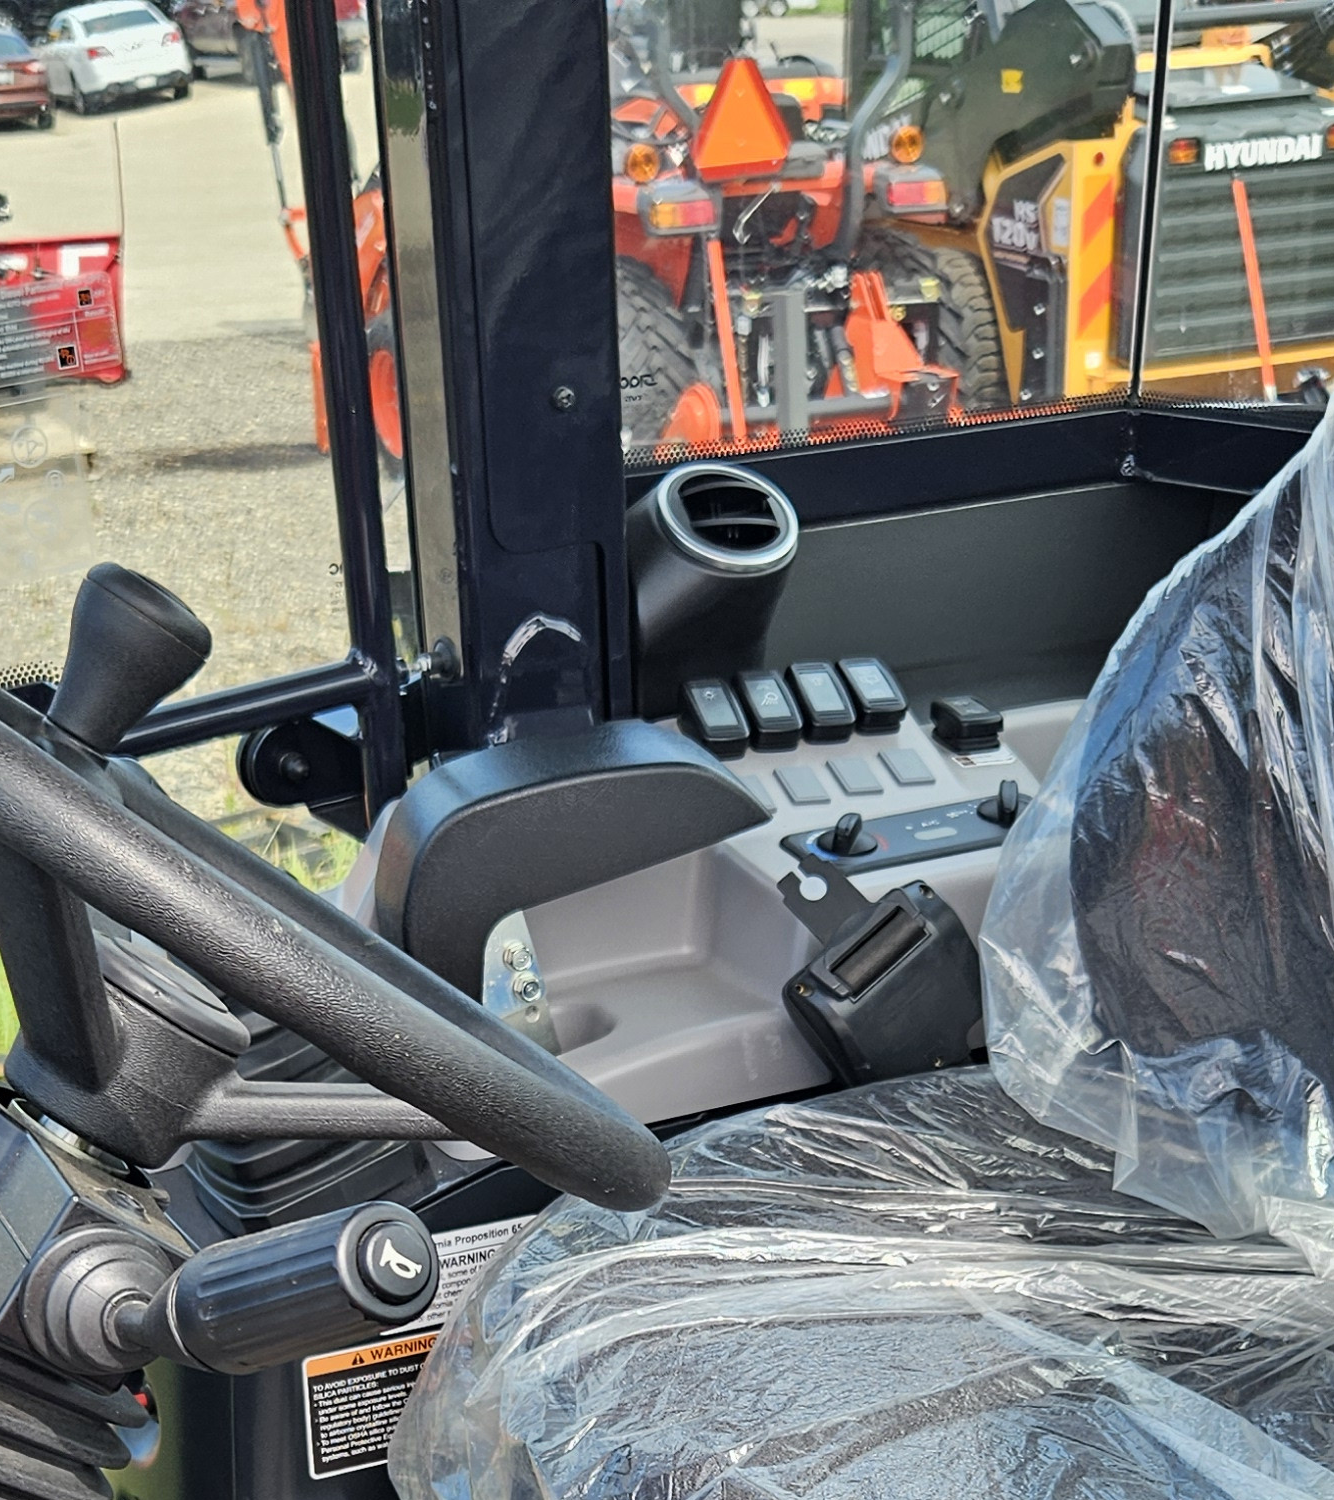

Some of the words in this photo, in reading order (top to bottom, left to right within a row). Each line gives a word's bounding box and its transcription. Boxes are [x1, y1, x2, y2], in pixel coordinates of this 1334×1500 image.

[1204, 133, 1324, 172] HYUNDAI
[455, 1226, 509, 1246] Proposition
[313, 1384, 324, 1393] TO
[324, 1380, 346, 1390] AVOID
[347, 1371, 387, 1385] EXPOSURE
[388, 1368, 398, 1376] TO
[399, 1363, 419, 1374] DUST
[313, 1390, 337, 1401] SILICA
[318, 1400, 332, 1408] This
